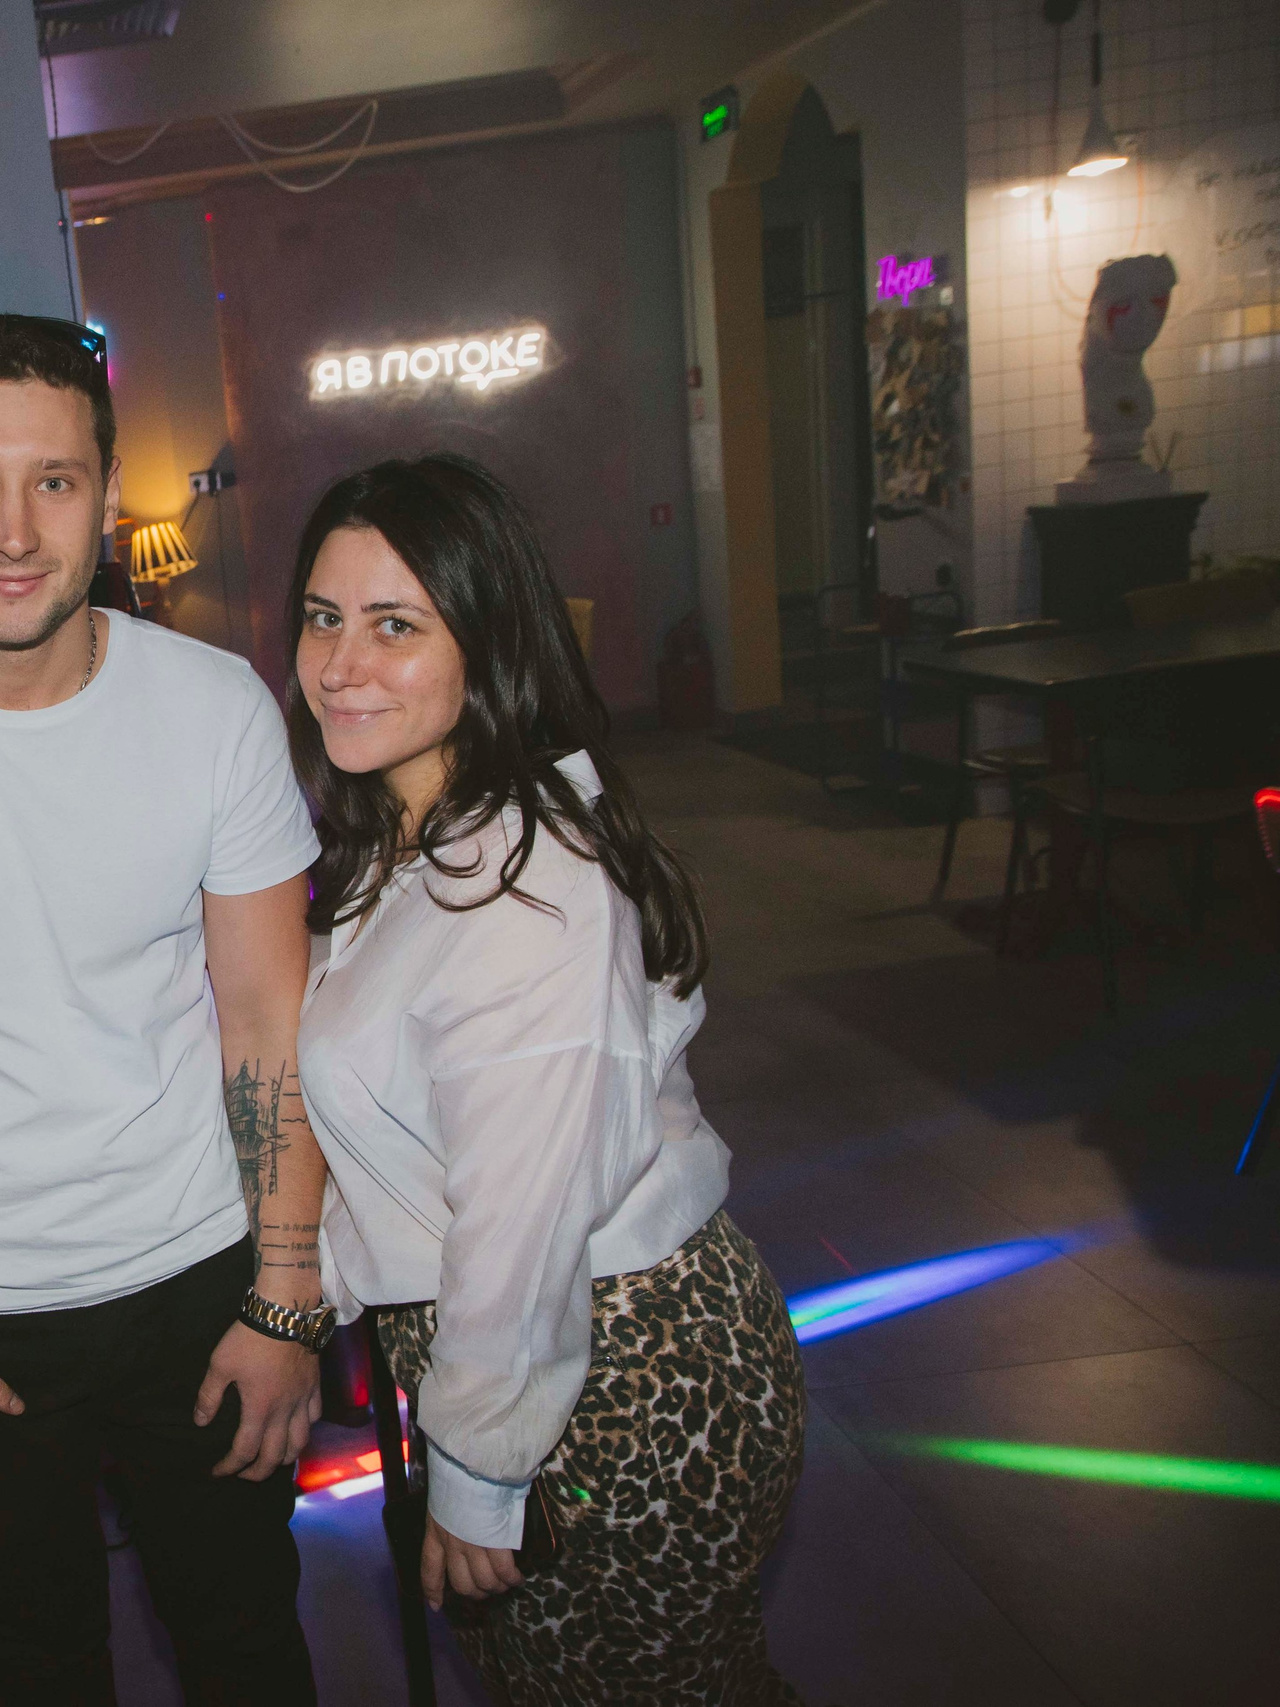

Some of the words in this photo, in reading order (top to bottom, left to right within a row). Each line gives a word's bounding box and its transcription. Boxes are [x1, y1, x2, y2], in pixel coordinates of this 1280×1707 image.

[317, 359, 342, 393] Я
[346, 355, 373, 389] В
[380, 332, 541, 385] ПОТОКЕ
